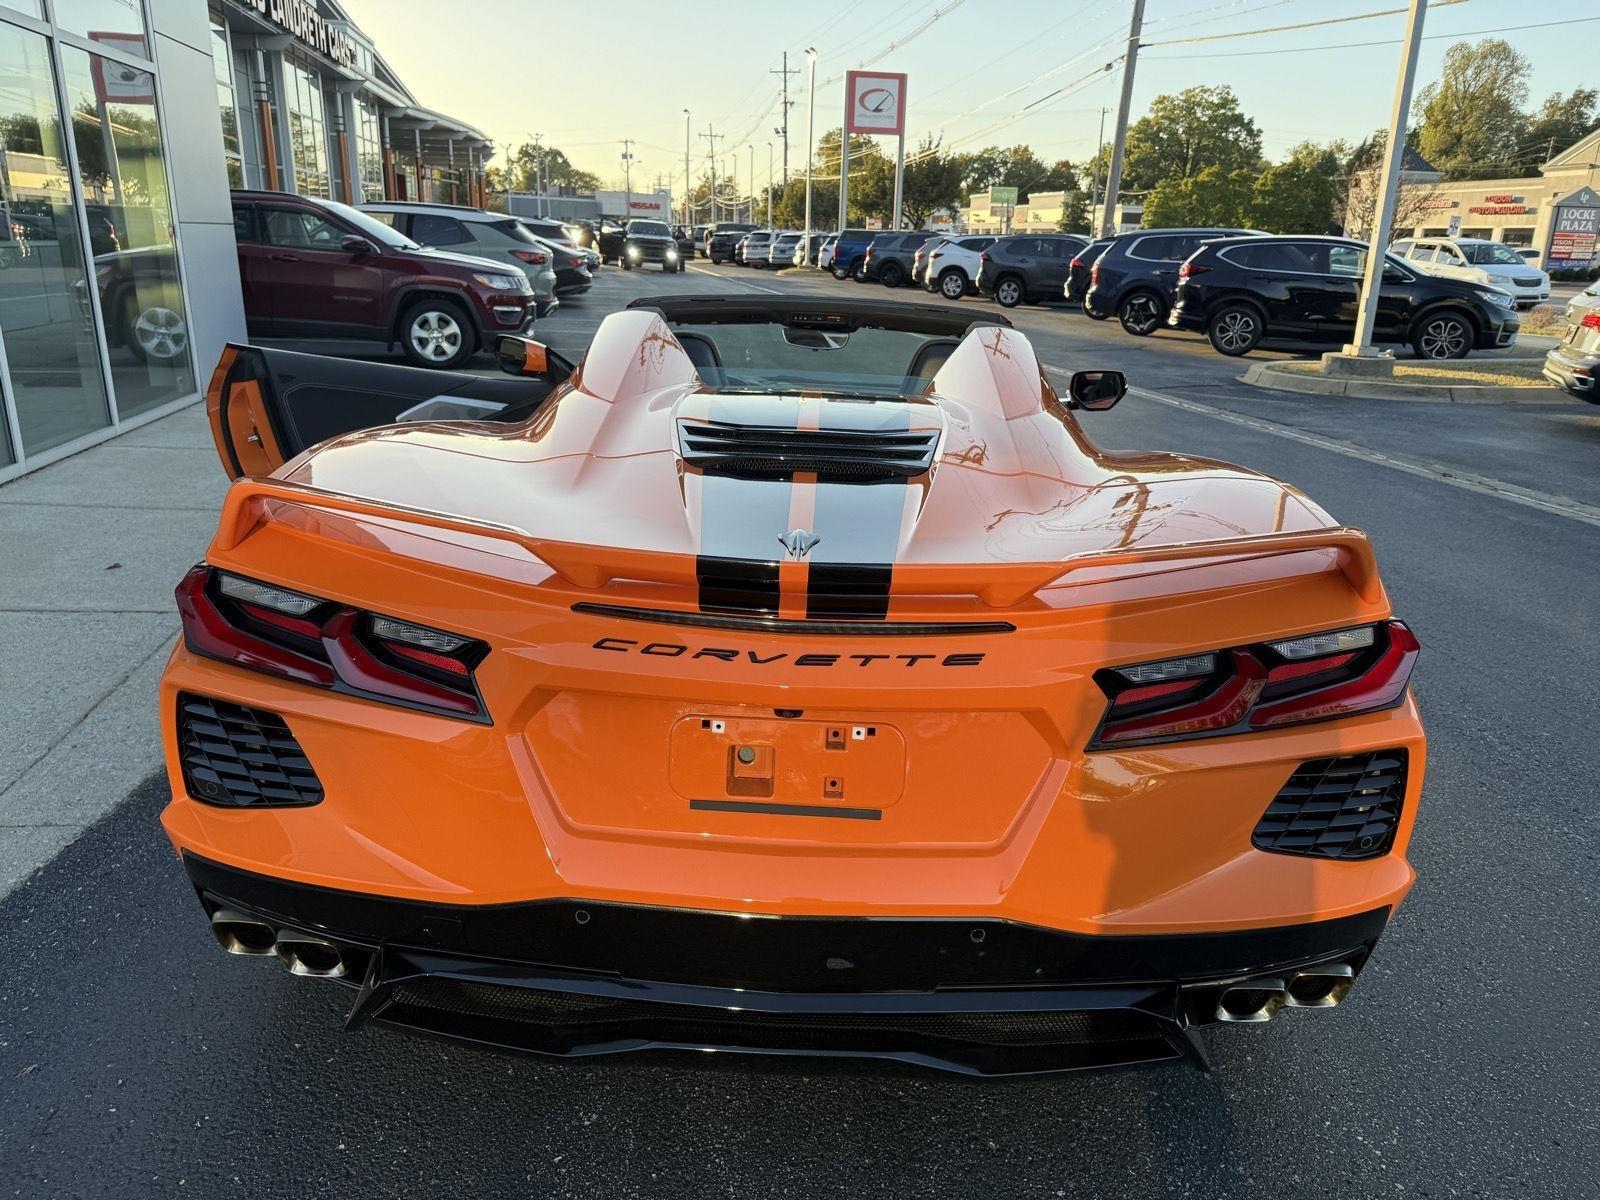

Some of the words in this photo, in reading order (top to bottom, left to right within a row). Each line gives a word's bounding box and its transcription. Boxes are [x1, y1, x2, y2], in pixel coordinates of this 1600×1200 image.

[270, 0, 327, 53] LANDRETH
[328, 23, 351, 68] CARS
[629, 202, 660, 210] NISSAN
[1563, 209, 1596, 219] LOCKE
[1561, 221, 1592, 230] PLAZA
[592, 637, 986, 667] CORVETTE
